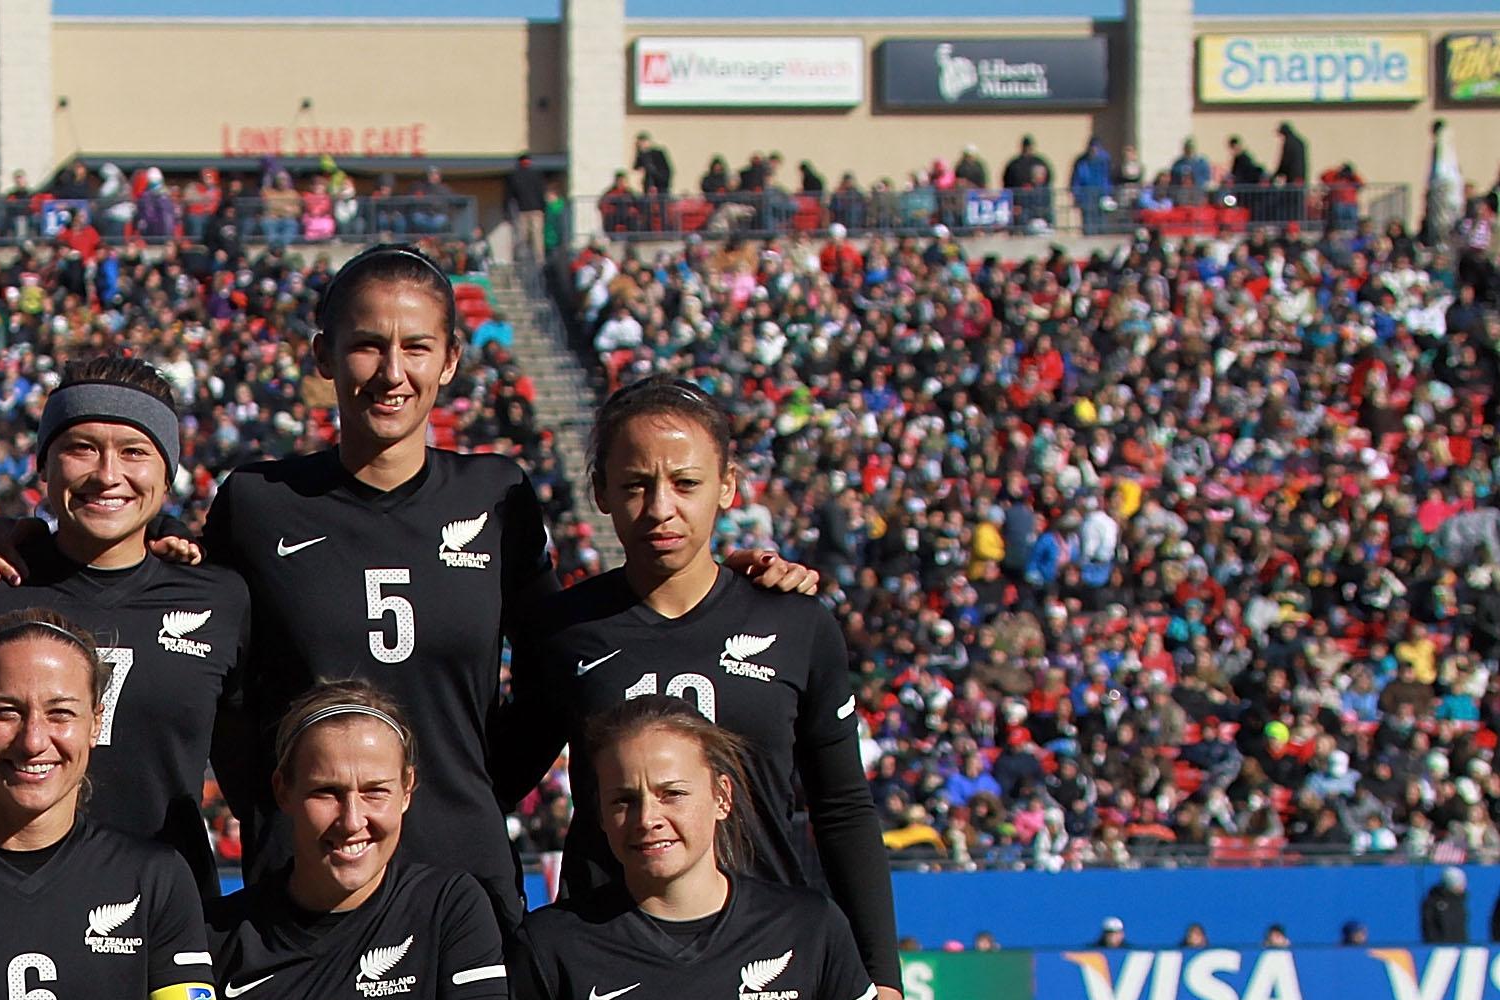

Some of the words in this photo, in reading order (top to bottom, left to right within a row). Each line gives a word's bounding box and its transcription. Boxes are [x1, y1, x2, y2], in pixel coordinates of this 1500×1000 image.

[1221, 38, 1408, 101] Snapple
[221, 122, 286, 157] LONE
[295, 123, 355, 157] STAR
[361, 122, 427, 157] CAFE
[446, 559, 486, 569] FOOTBALL
[365, 568, 415, 664] 5
[165, 644, 206, 658] FOOTBALL
[726, 666, 771, 682] FOOTBALL
[94, 647, 134, 746] 7
[91, 944, 136, 954] FOOTBALL
[355, 981, 376, 991] NEW
[376, 975, 416, 990] ZEALAND
[363, 985, 411, 998] FOOTBALL
